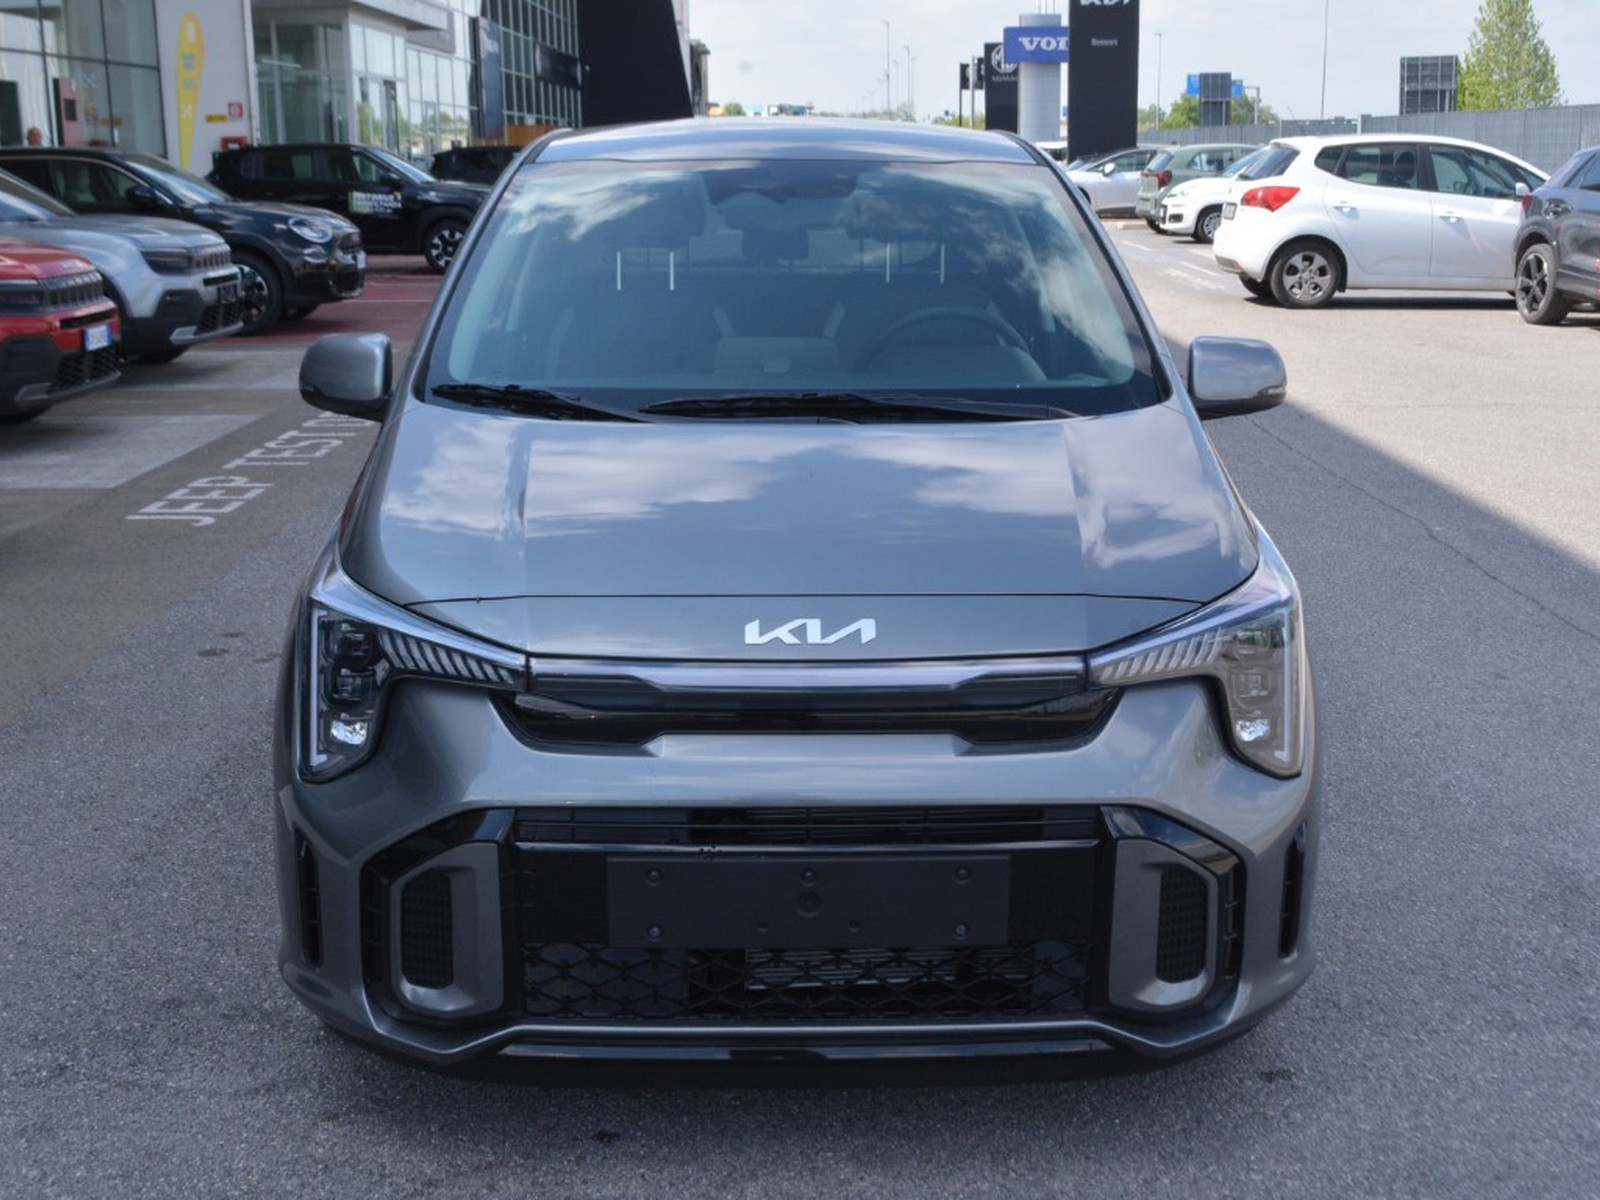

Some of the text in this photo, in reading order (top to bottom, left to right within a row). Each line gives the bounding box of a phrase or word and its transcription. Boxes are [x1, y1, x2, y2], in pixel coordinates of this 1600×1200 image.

[126, 475, 275, 527] JEEP
[223, 430, 356, 469] TEST
[744, 618, 876, 644] KIA
